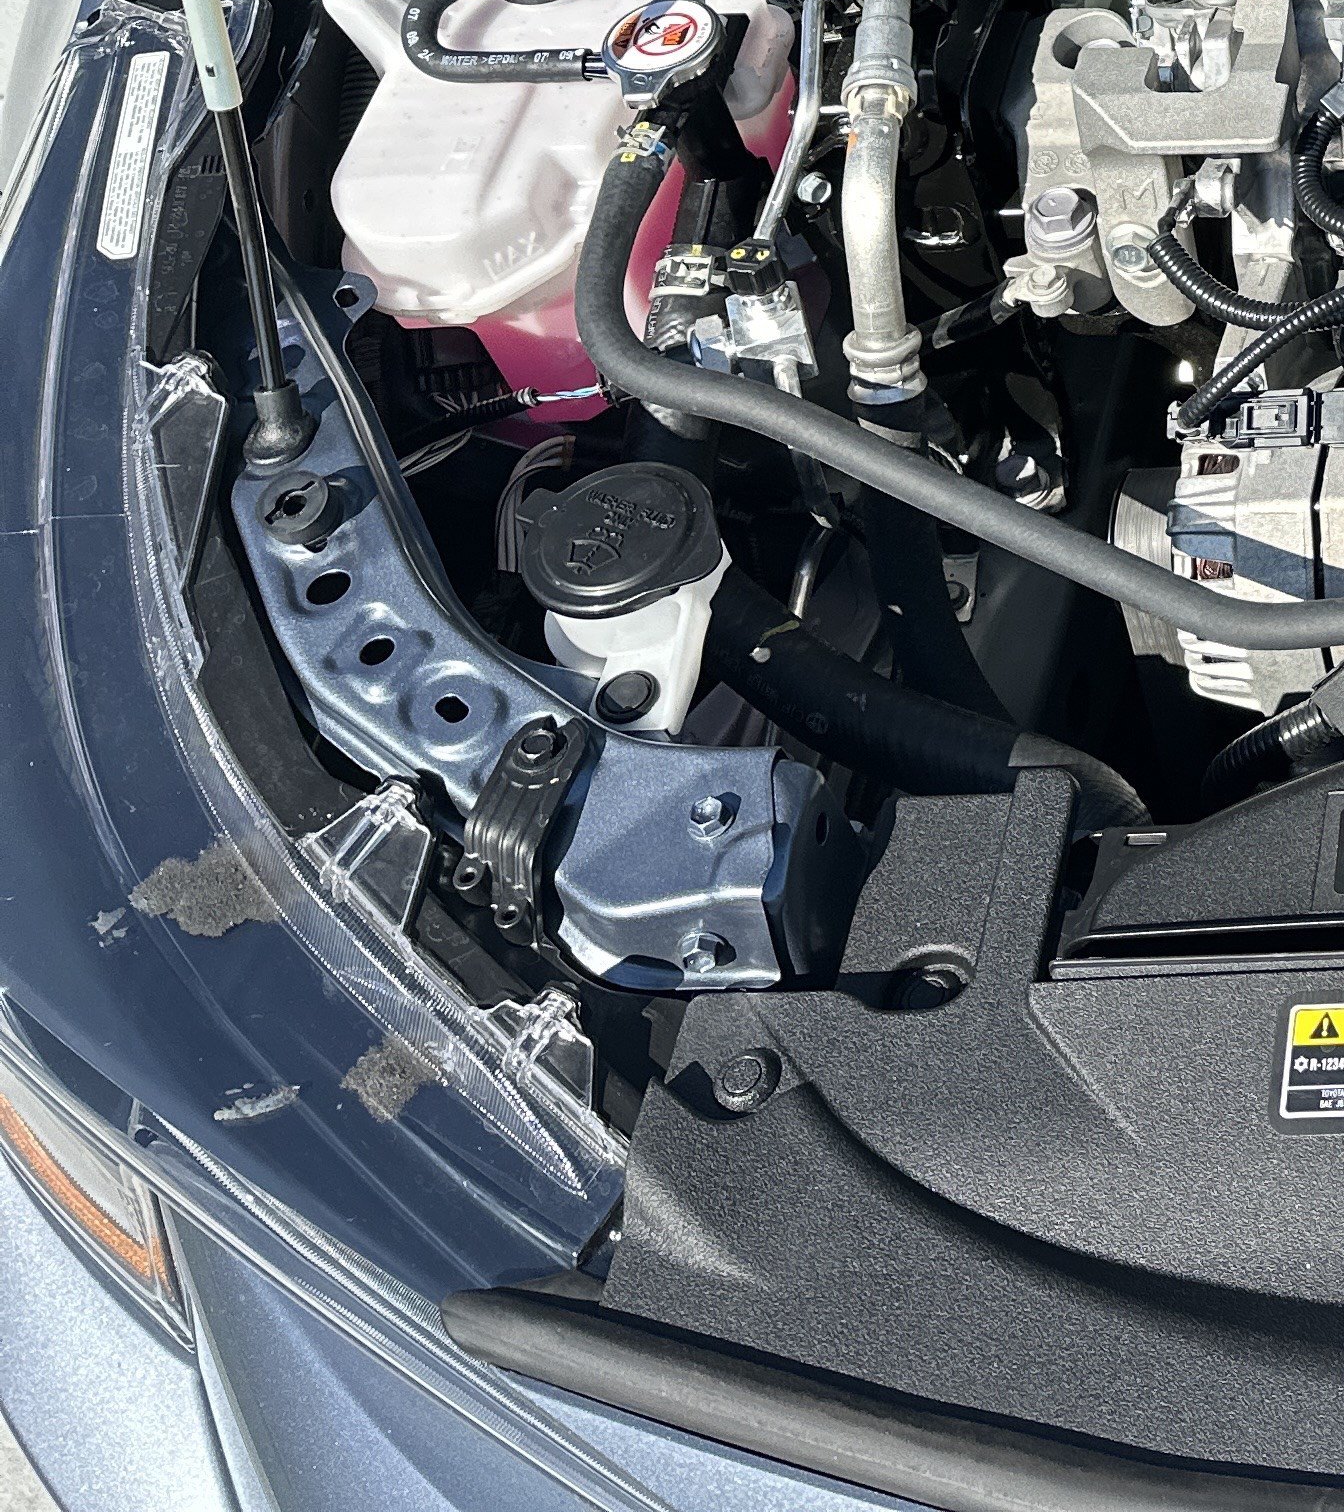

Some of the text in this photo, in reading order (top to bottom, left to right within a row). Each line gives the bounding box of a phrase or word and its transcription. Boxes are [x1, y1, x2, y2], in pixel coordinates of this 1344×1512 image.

[440, 54, 478, 66] WATER
[483, 231, 541, 282] MAX
[586, 489, 638, 513] WASHER
[1320, 1088, 1344, 1098] TOYOTA
[1319, 1099, 1334, 1109] SAE
